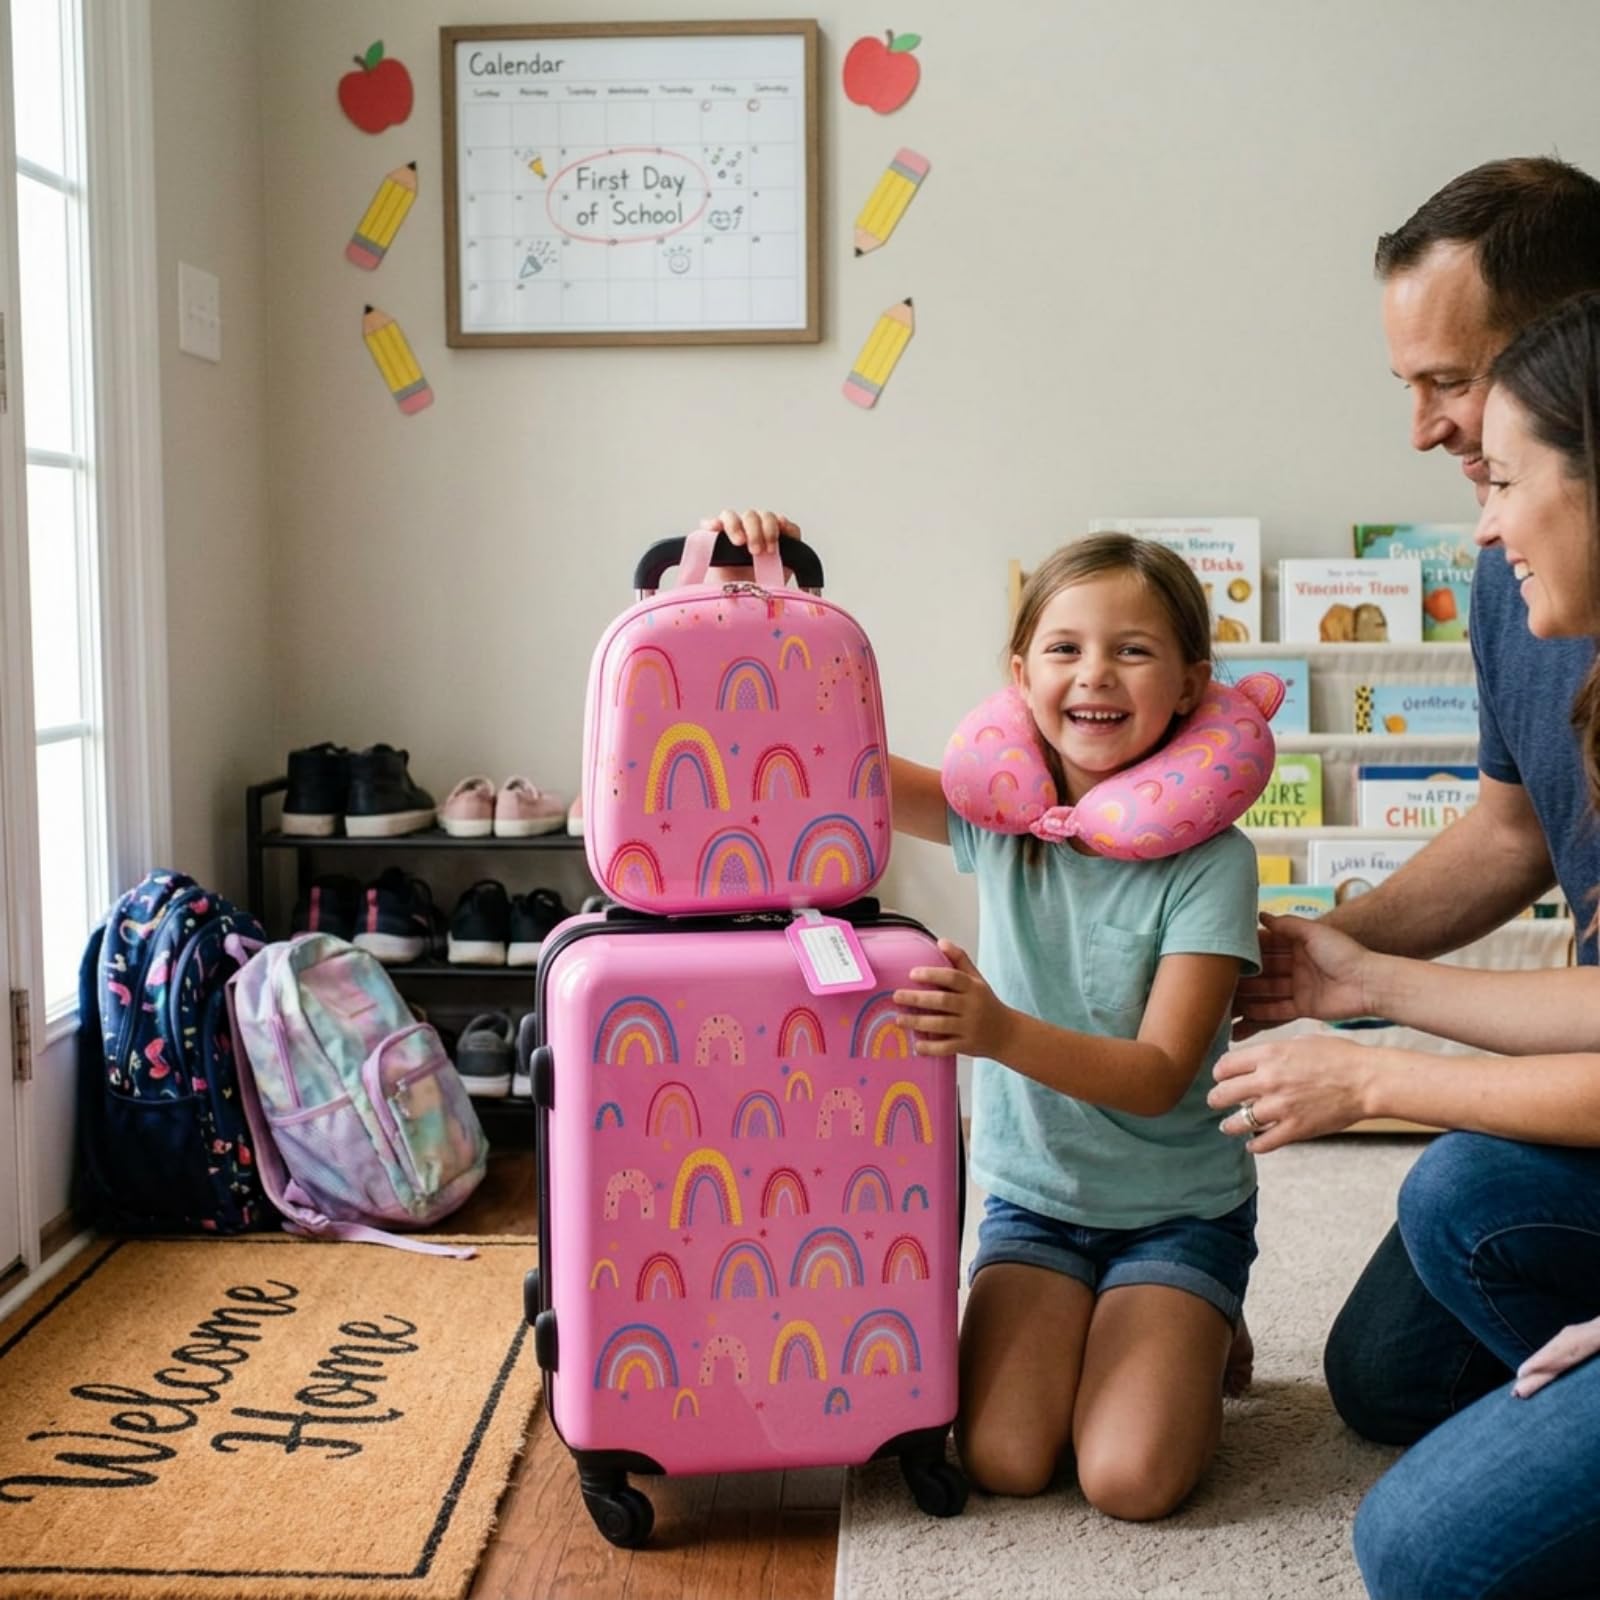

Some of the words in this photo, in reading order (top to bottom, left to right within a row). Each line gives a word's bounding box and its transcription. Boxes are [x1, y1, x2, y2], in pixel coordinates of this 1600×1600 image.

[468, 51, 565, 76] Calendar
[576, 167, 629, 192] First
[643, 165, 686, 197] Day
[576, 202, 599, 226] of
[612, 201, 683, 226] School
[0, 1279, 299, 1502] Welcome
[210, 1314, 420, 1460] Home
